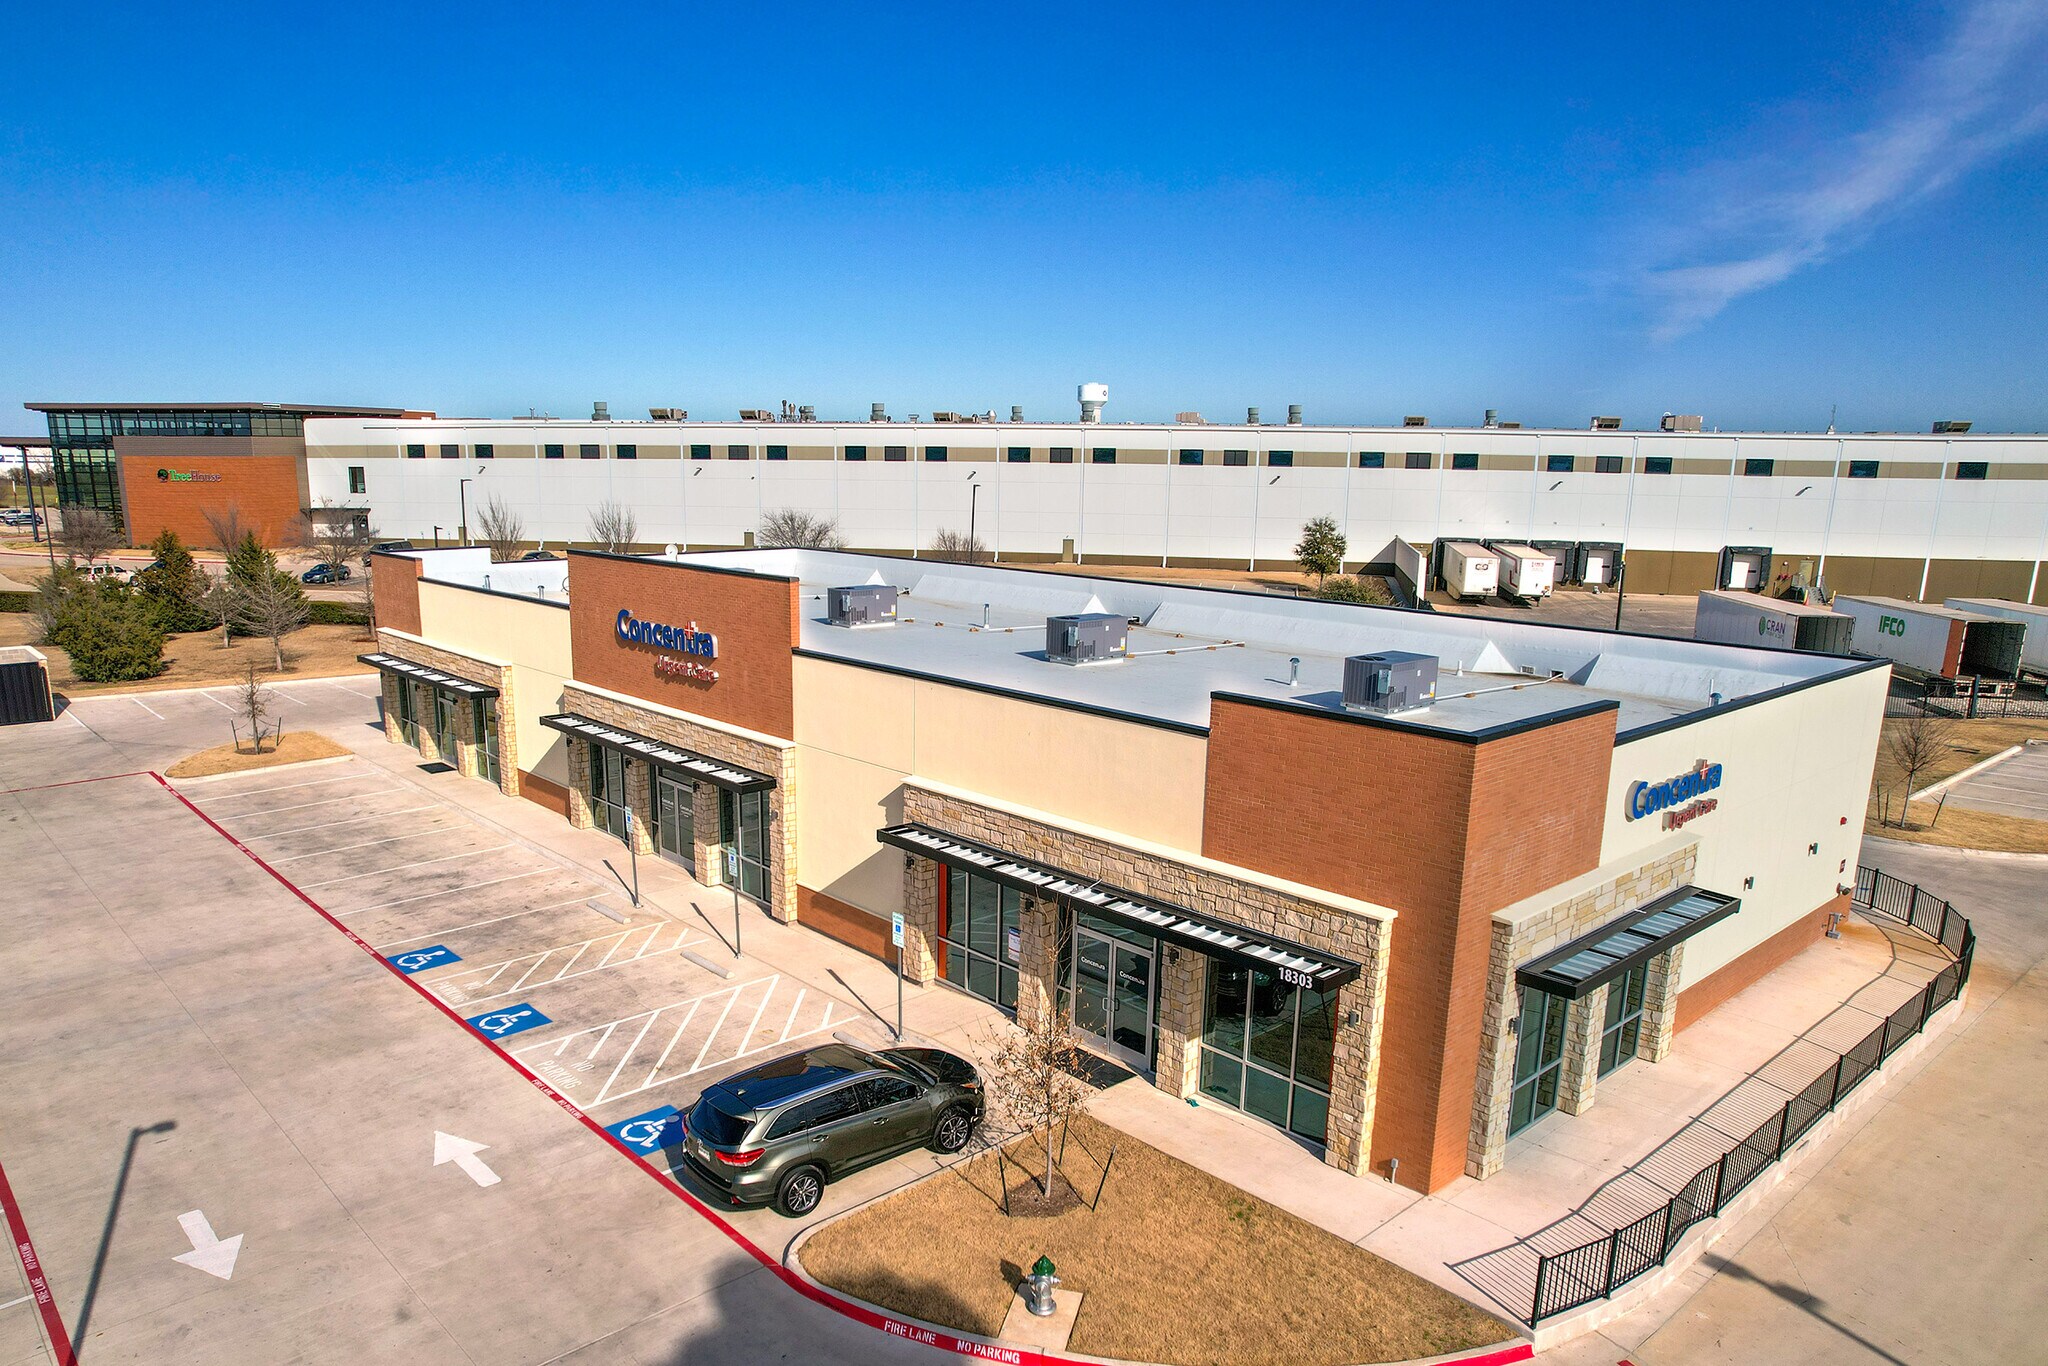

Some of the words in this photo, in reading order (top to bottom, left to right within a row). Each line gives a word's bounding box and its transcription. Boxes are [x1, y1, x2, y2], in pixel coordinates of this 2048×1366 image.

[616, 609, 718, 658] Concentra
[1766, 619, 1786, 635] CRAN
[1878, 615, 1906, 638] IFCO
[1630, 759, 1722, 820] Concentra
[1279, 967, 1313, 989] 18303
[535, 1060, 582, 1089] PARKING
[570, 1060, 595, 1072] NO
[884, 1320, 906, 1337] FIRE
[908, 1327, 936, 1345] LANE
[957, 1340, 972, 1352] NO
[973, 1343, 1020, 1364] PARKING
